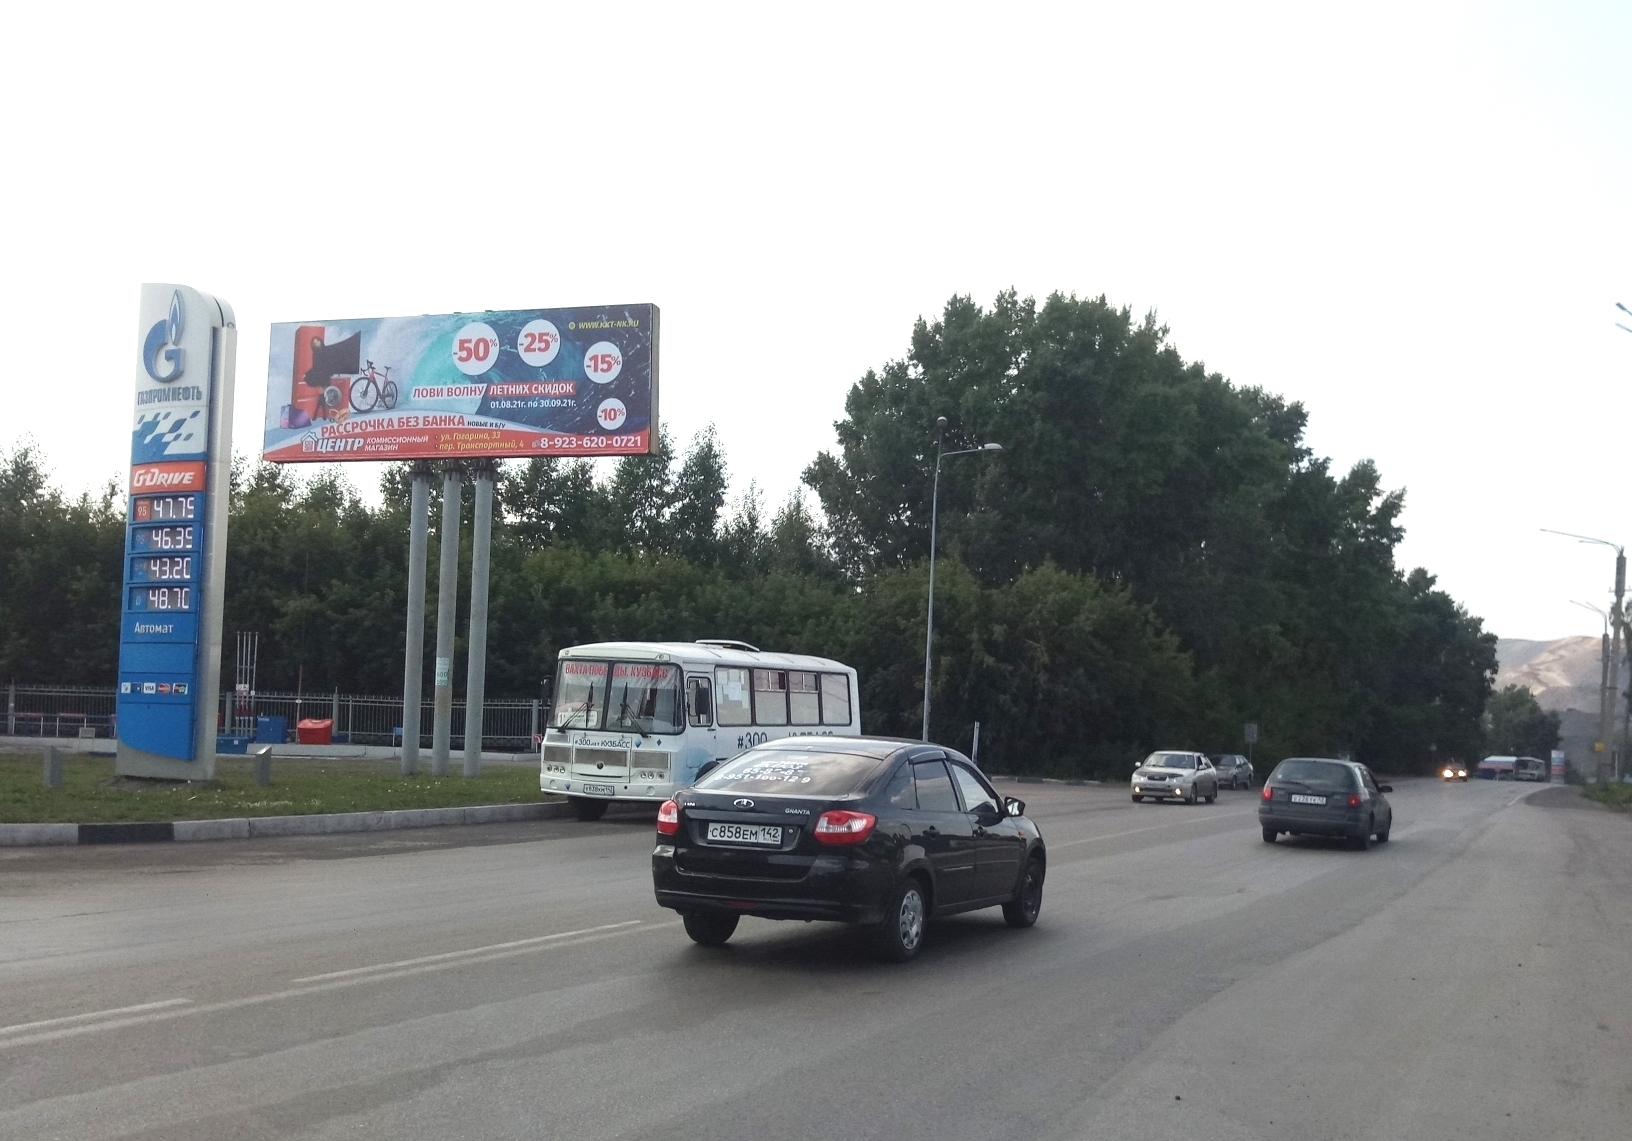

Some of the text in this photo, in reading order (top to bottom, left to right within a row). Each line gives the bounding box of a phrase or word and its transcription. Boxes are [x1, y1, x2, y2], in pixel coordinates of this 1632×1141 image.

[519, 332, 558, 353] -25%
[453, 338, 498, 362] -50%
[586, 354, 621, 373] -15%
[138, 386, 202, 405] ГАЗПРОМНЕФТЬ
[412, 383, 573, 398] ЛОВИ ВОЛНУ ЛЕТНИХ СКИДОК
[490, 401, 526, 409] 01.08.21г.
[540, 399, 577, 407] 30.09.21г.
[598, 408, 625, 422] -10%
[321, 417, 394, 437] РАССРОЧКА
[397, 416, 419, 428] БЕЗ
[423, 415, 465, 427] БАНКА
[366, 435, 429, 443] КОМИССИОННЫЙ
[440, 434, 452, 442] ул.
[492, 431, 501, 439] 33
[540, 436, 641, 448] 8-923-620-0721
[316, 438, 364, 453] ЦЕНТР
[439, 443, 455, 451] пер.
[137, 506, 147, 517] 95
[134, 621, 174, 633] Автомат
[565, 664, 588, 675] ВАХТА
[784, 807, 811, 815] GRANTA
[711, 825, 779, 841] С858ЕМ 142
